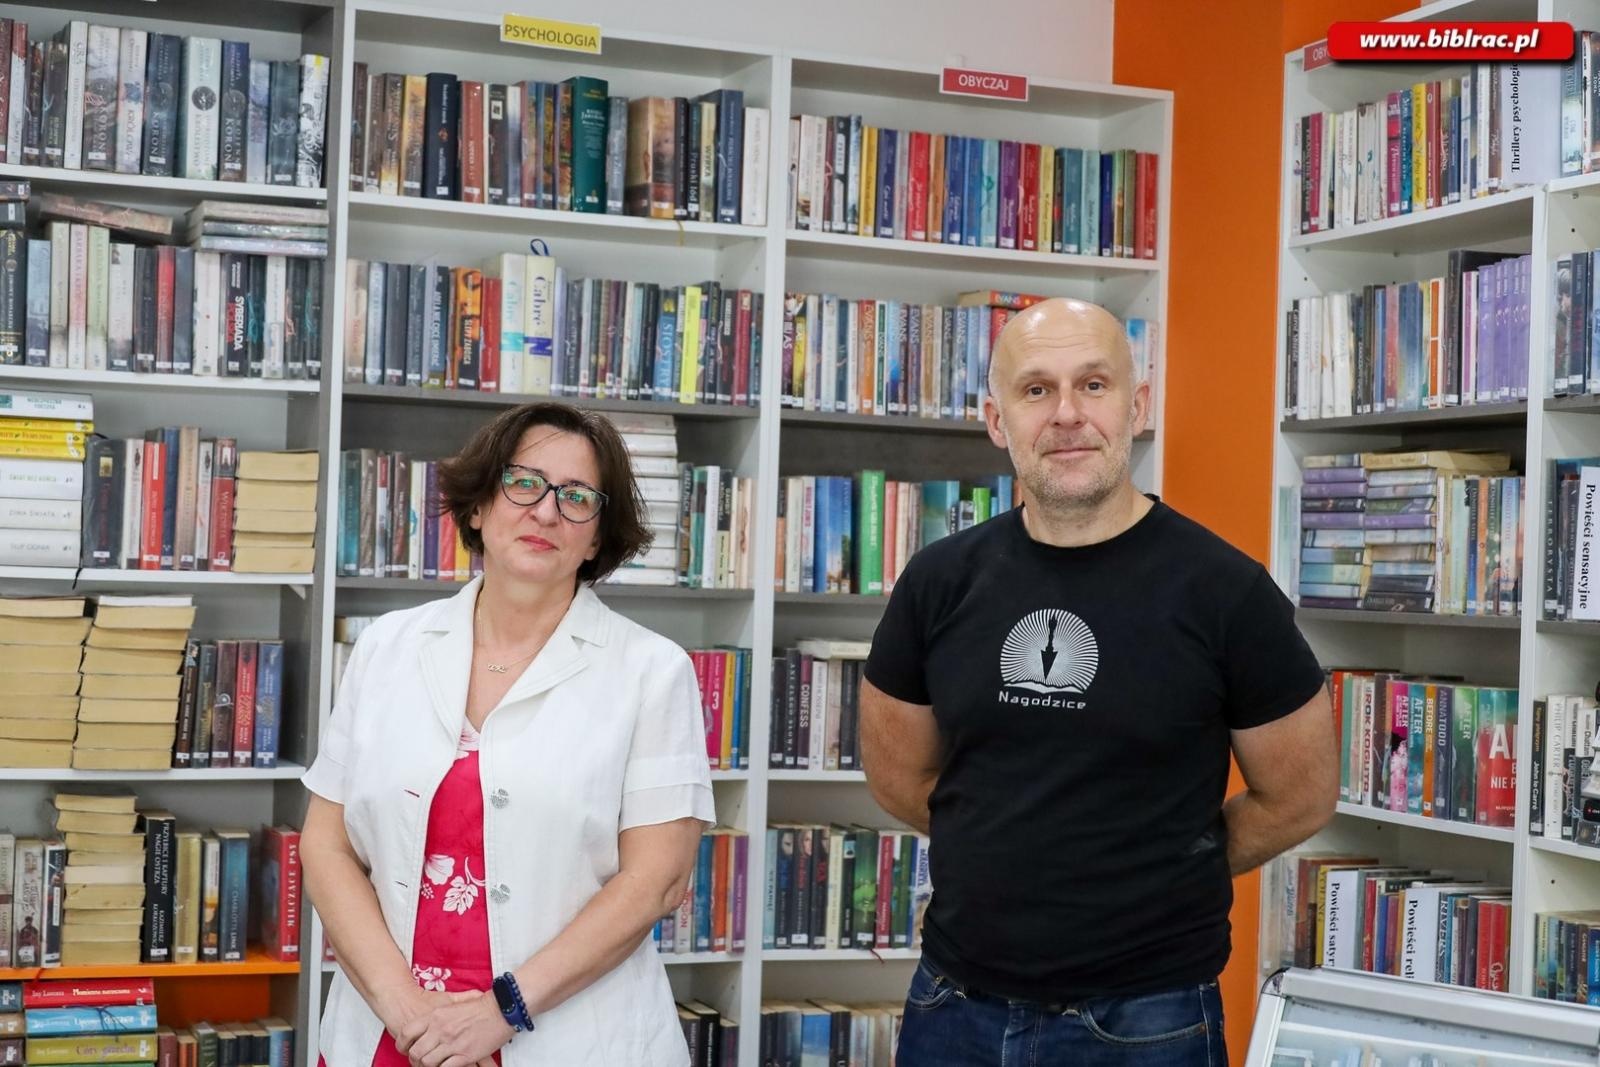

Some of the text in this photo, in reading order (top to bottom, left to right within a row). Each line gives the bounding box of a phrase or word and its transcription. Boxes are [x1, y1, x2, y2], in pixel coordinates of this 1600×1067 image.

[504, 23, 597, 48] PSYCHOLOGIA
[958, 73, 1009, 91] OBYCZAJ
[97, 106, 108, 154] KORON
[150, 111, 161, 158] KORON
[224, 117, 234, 161] KORON
[1511, 125, 1521, 172] Thrillery
[234, 296, 244, 351] SYBERIADA
[910, 309, 919, 343] EVANS
[957, 311, 965, 344] EVANS
[659, 324, 674, 386] SIOSTRY
[1578, 484, 1596, 609] Powieści sensacyjne
[800, 684, 810, 728] CONFESS
[998, 690, 1087, 710] Nagodzice
[1414, 698, 1423, 734] AFTER
[1463, 702, 1472, 739] AFTER
[288, 844, 296, 864] PSY
[1329, 883, 1340, 931] Powieści
[1406, 900, 1418, 954] Powieści
